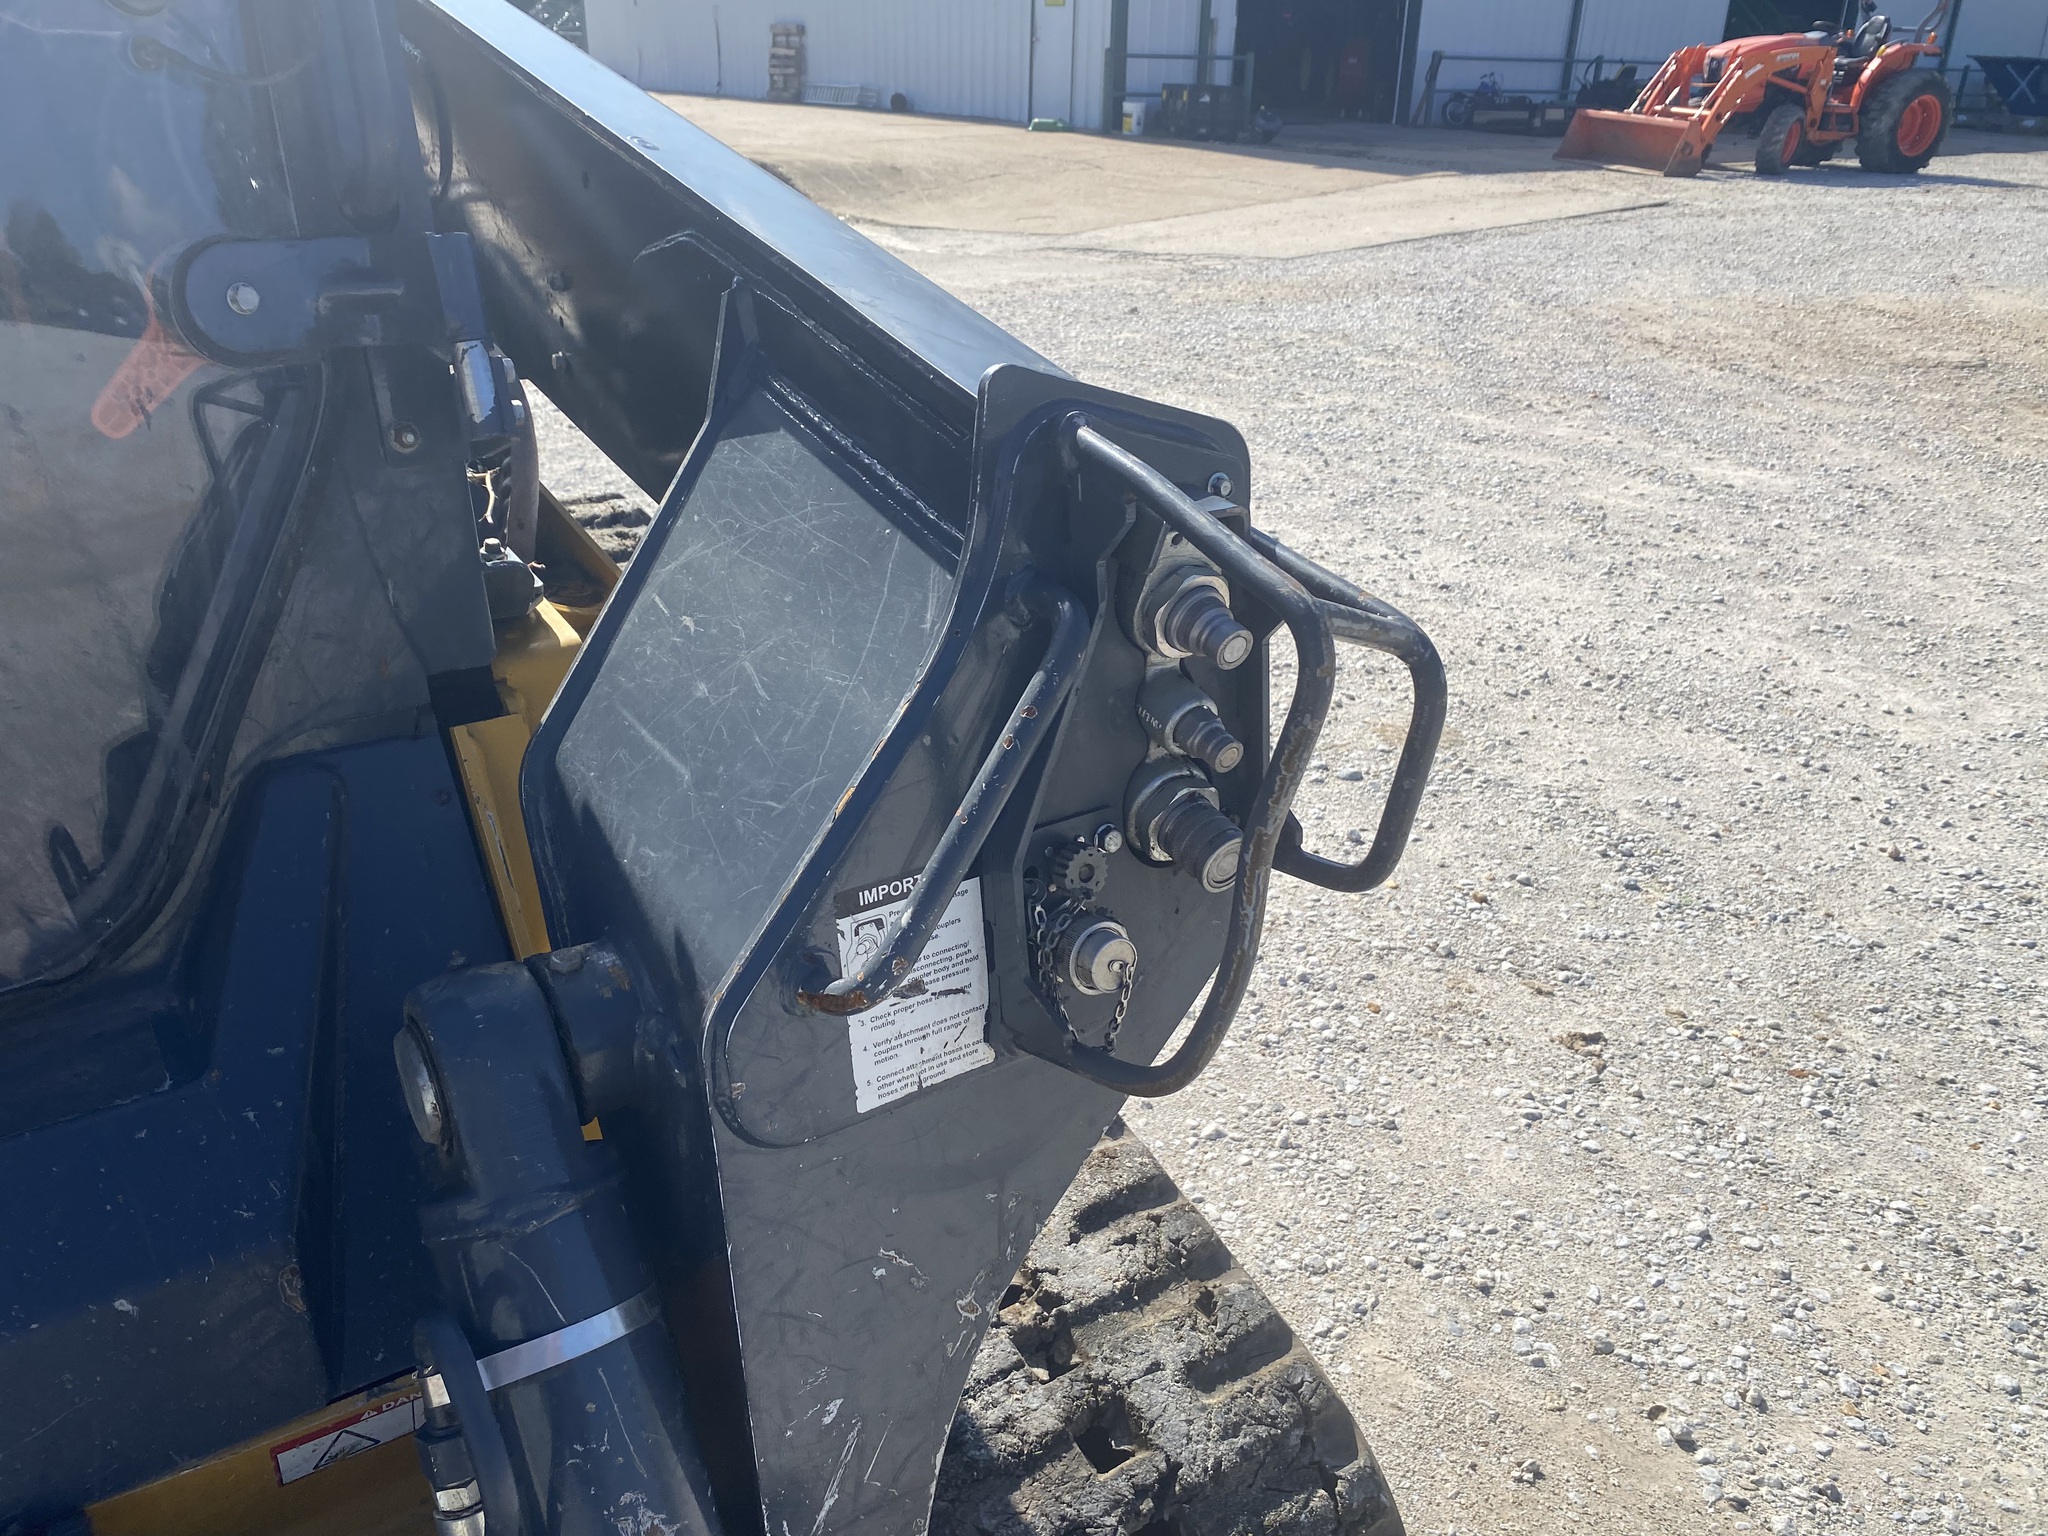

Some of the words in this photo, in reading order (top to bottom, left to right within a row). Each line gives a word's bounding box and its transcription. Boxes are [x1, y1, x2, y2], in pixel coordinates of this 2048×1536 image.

[935, 917, 961, 930] ouplers
[923, 953, 930, 961] to
[933, 964, 950, 975] body
[951, 960, 964, 968] and
[964, 954, 979, 964] hold
[955, 949, 972, 959] push
[941, 967, 971, 981] pressure.
[870, 1011, 892, 1023] Check
[893, 1003, 915, 1016] proper
[916, 997, 932, 1007] hose
[872, 1036, 893, 1049] Verify
[893, 1024, 931, 1040] attachment
[931, 1017, 948, 1028] does
[949, 1013, 960, 1023] not
[961, 1004, 985, 1016] contact
[873, 1043, 903, 1058] couplers
[904, 1032, 930, 1047] through
[931, 1027, 943, 1036] full
[943, 1022, 962, 1032] range
[963, 1016, 970, 1024] of
[874, 1053, 899, 1066] motion.
[876, 1067, 905, 1083] Connect
[943, 1046, 963, 1058] hoses
[972, 1038, 983, 1046] eac
[877, 1080, 896, 1091] other
[896, 1073, 914, 1084] when
[928, 1063, 935, 1072] in
[936, 1060, 948, 1069] use
[948, 1053, 961, 1063] and
[962, 1048, 978, 1058] store
[877, 1087, 899, 1100] hoses
[900, 1083, 909, 1092] off
[922, 1069, 947, 1084] ground.
